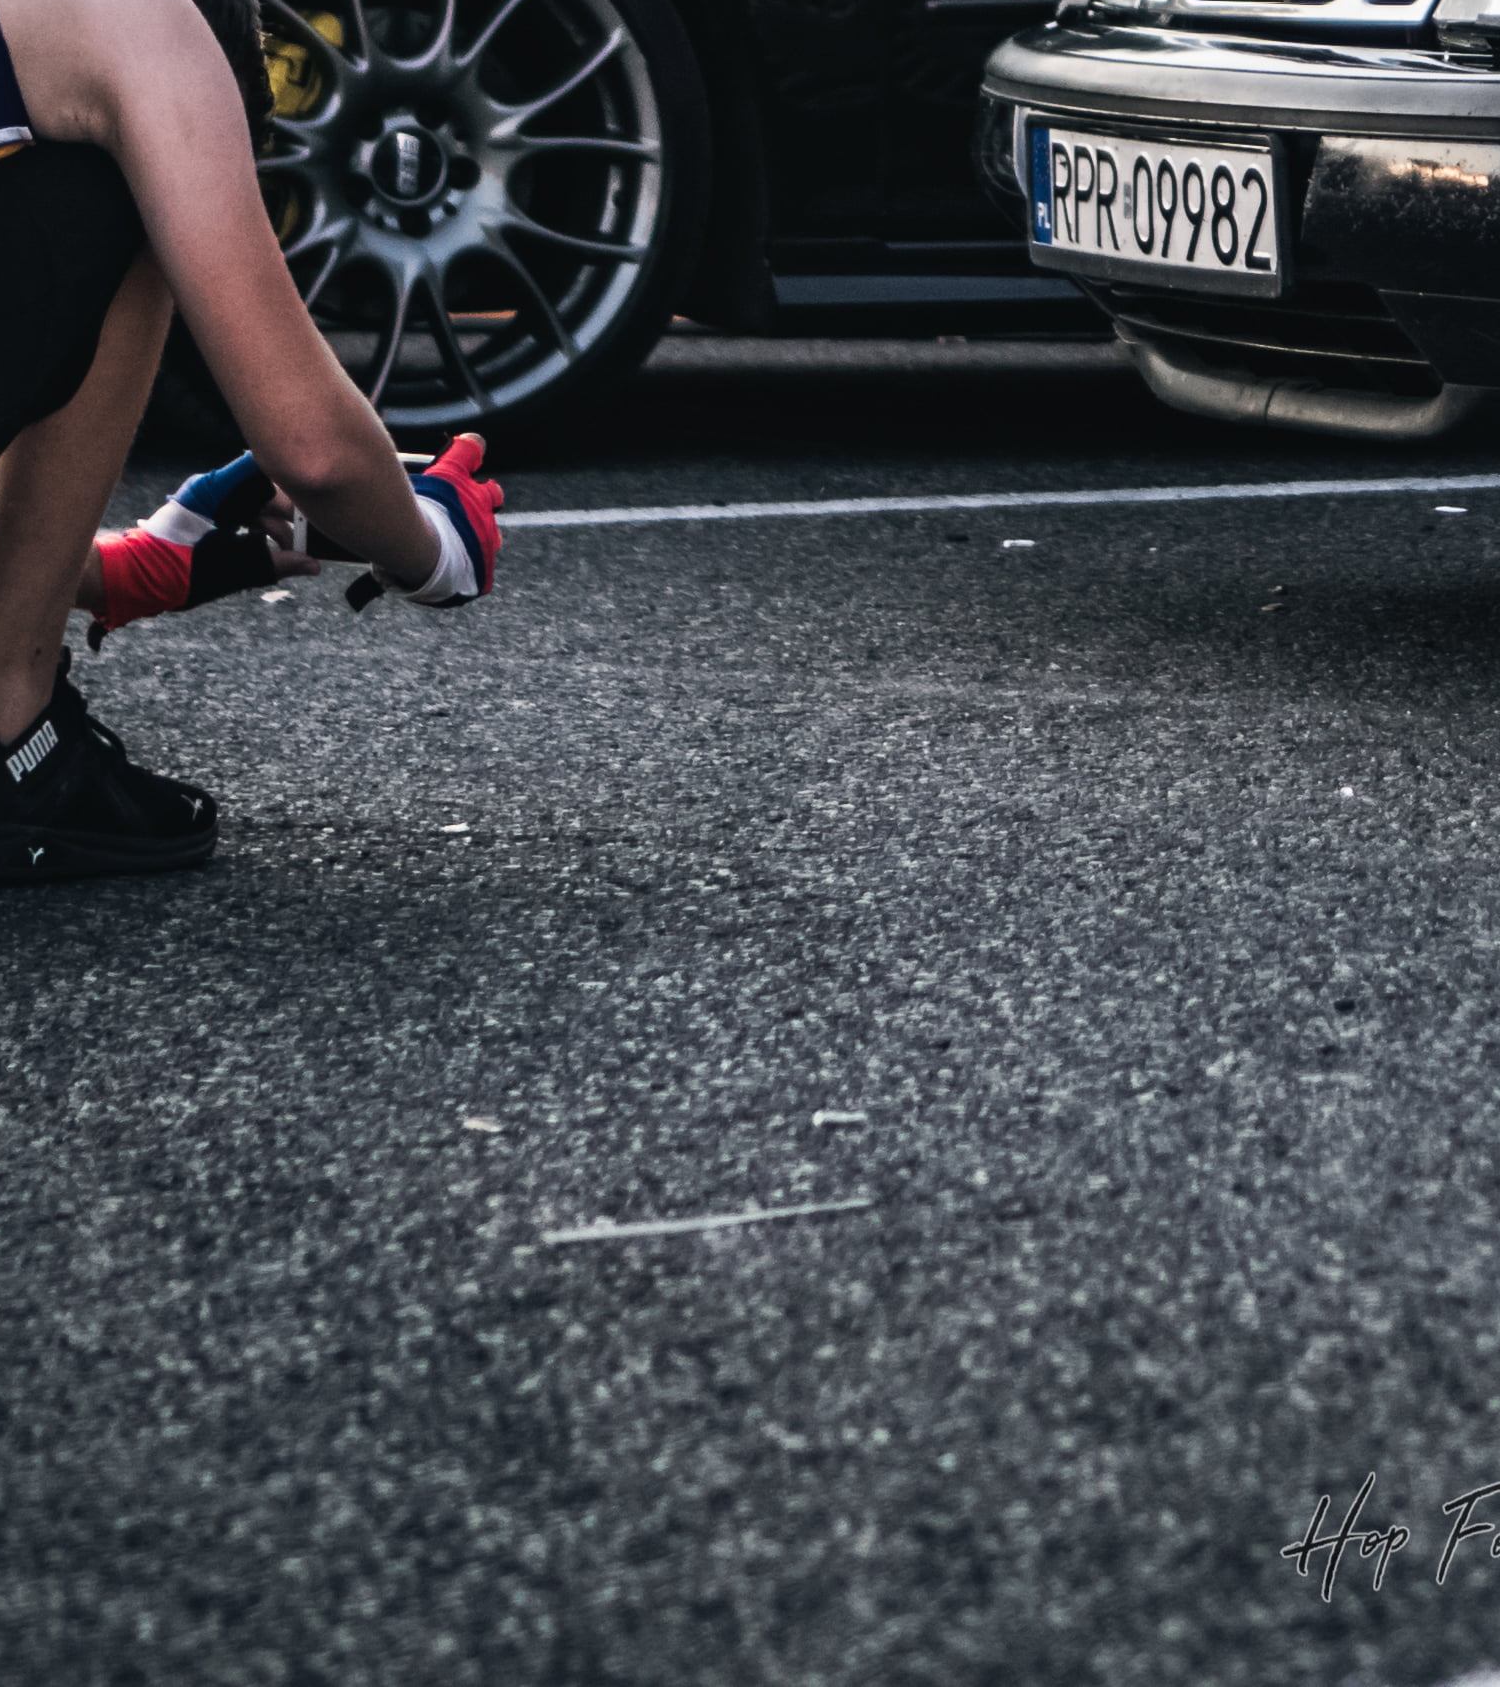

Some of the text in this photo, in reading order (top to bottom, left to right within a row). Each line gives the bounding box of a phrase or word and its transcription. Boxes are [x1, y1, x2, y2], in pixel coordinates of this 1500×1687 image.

[1037, 201, 1051, 229] PL
[1051, 141, 1272, 271] RPR 09982
[6, 720, 59, 783] PUMA
